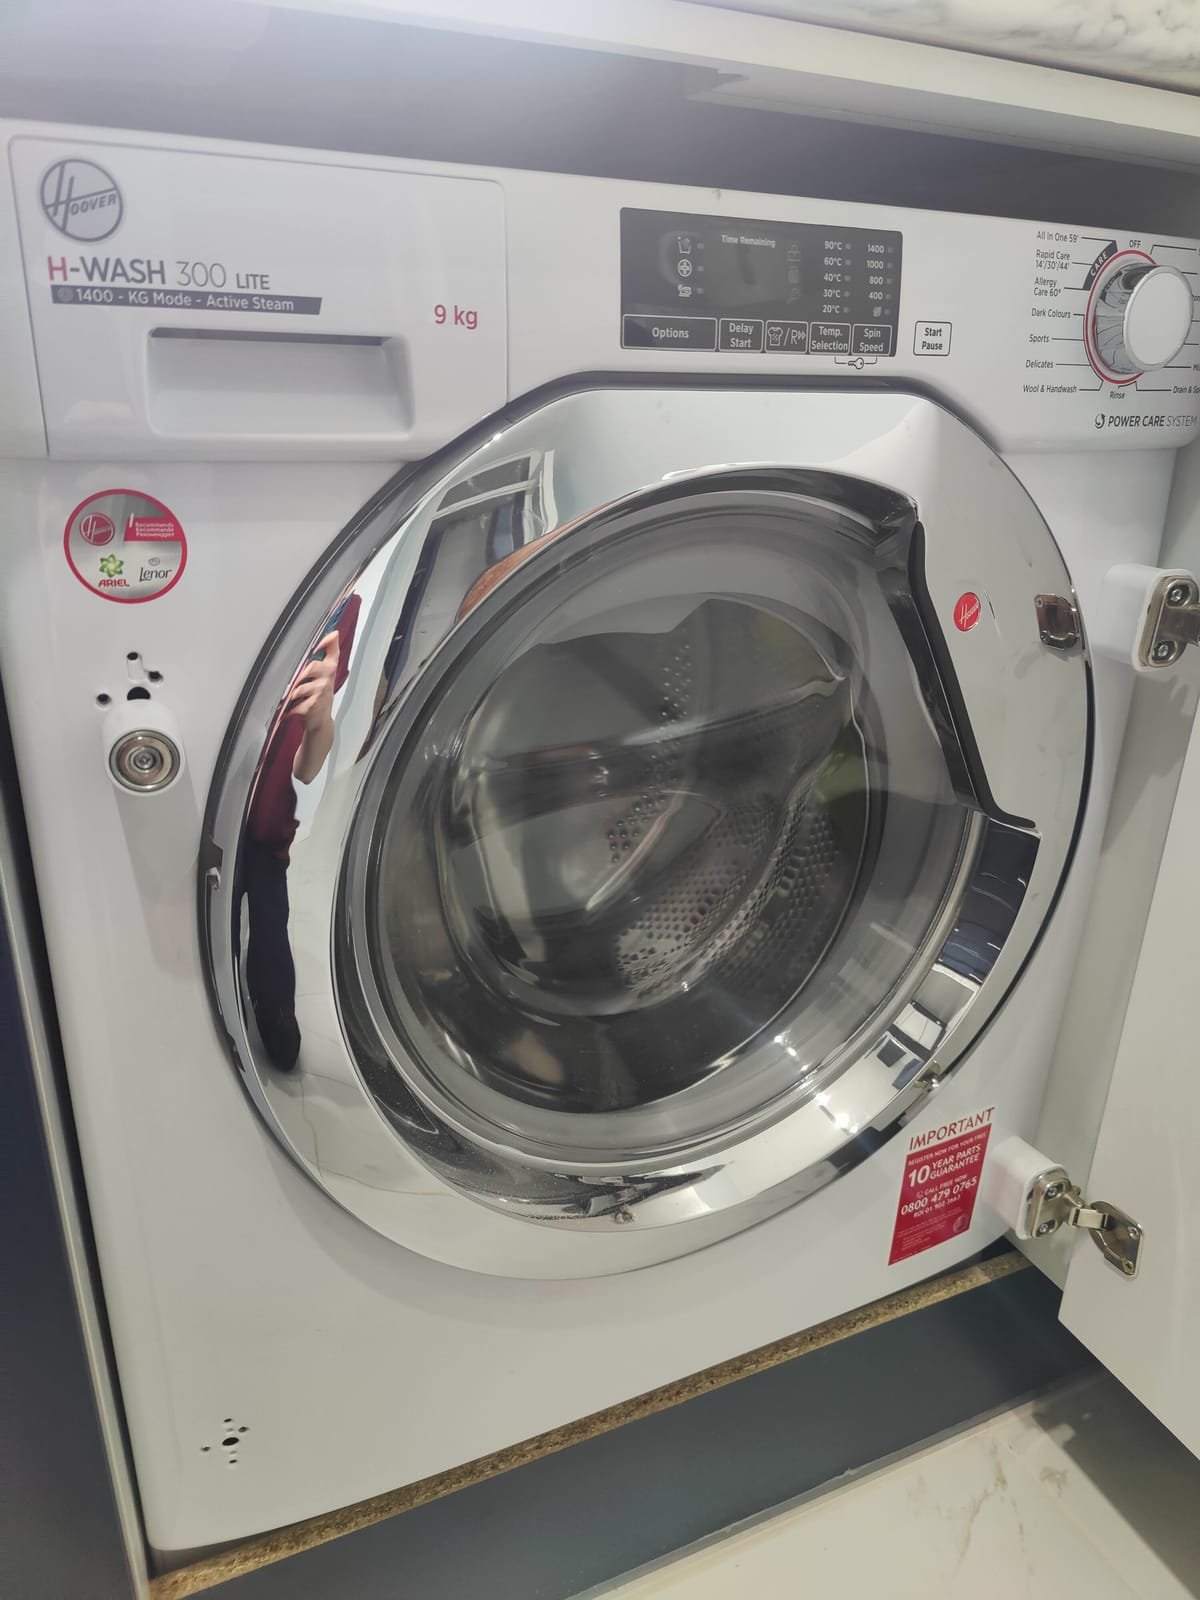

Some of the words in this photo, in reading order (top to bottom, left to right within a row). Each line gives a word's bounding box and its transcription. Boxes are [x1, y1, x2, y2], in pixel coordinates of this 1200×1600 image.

[722, 234, 739, 244] Time
[740, 236, 776, 248] Remaining
[1036, 231, 1046, 240] All
[1054, 232, 1068, 242] One
[824, 241, 842, 250] 90°C
[867, 244, 884, 253] 1400
[1129, 240, 1142, 248] OFF
[1036, 249, 1055, 260] Rapid
[1056, 251, 1071, 260] Care
[824, 257, 842, 266] 60°C
[866, 260, 884, 269] 1000
[1091, 251, 1108, 276] CARE
[47, 256, 166, 285] H-WASH
[176, 261, 227, 288] 300
[236, 273, 270, 290] LITE
[824, 273, 842, 282] 40°C
[869, 276, 883, 285] 800
[1034, 277, 1057, 288] Allergy
[823, 289, 841, 298] 30°C
[869, 292, 883, 301] 400
[1033, 287, 1048, 296] Care
[77, 288, 113, 302] 1400
[128, 291, 148, 304] KG
[153, 292, 191, 306] Mode
[206, 294, 248, 309] Active
[252, 297, 294, 311] Steam
[822, 305, 840, 313] 20°C
[1031, 307, 1046, 317] Dark
[1047, 309, 1071, 318] Colours
[434, 304, 446, 324] 9
[454, 305, 477, 330] kg
[652, 327, 689, 339] Options
[729, 323, 754, 334] Delay
[819, 326, 843, 338] Temp.
[863, 328, 881, 339] Spin
[924, 327, 942, 336] Start
[730, 338, 752, 348] Start
[1029, 334, 1050, 343] Sports
[811, 340, 848, 351] Selection
[859, 343, 883, 353] Speed
[921, 341, 943, 350] Pause
[1025, 360, 1054, 368] Delicates
[1023, 384, 1040, 393] Wool
[1046, 384, 1077, 393] Handwash
[1110, 391, 1125, 399] Rinse
[1108, 415, 1140, 427] POWER
[1142, 415, 1165, 427] CARE
[1166, 415, 1198, 427] SYSTEM
[139, 567, 173, 582] Lenor
[98, 579, 130, 588] ARIEL
[909, 1107, 995, 1150] IMPORTANT
[932, 1155, 954, 1169] YEAR
[956, 1143, 981, 1161] PARTS
[930, 1153, 979, 1179] GUARANTEE
[909, 1165, 930, 1187] 10
[901, 1197, 928, 1215] 0800
[931, 1188, 950, 1202] 479
[953, 1176, 977, 1194] 0765
[925, 1186, 938, 1195] CALL
